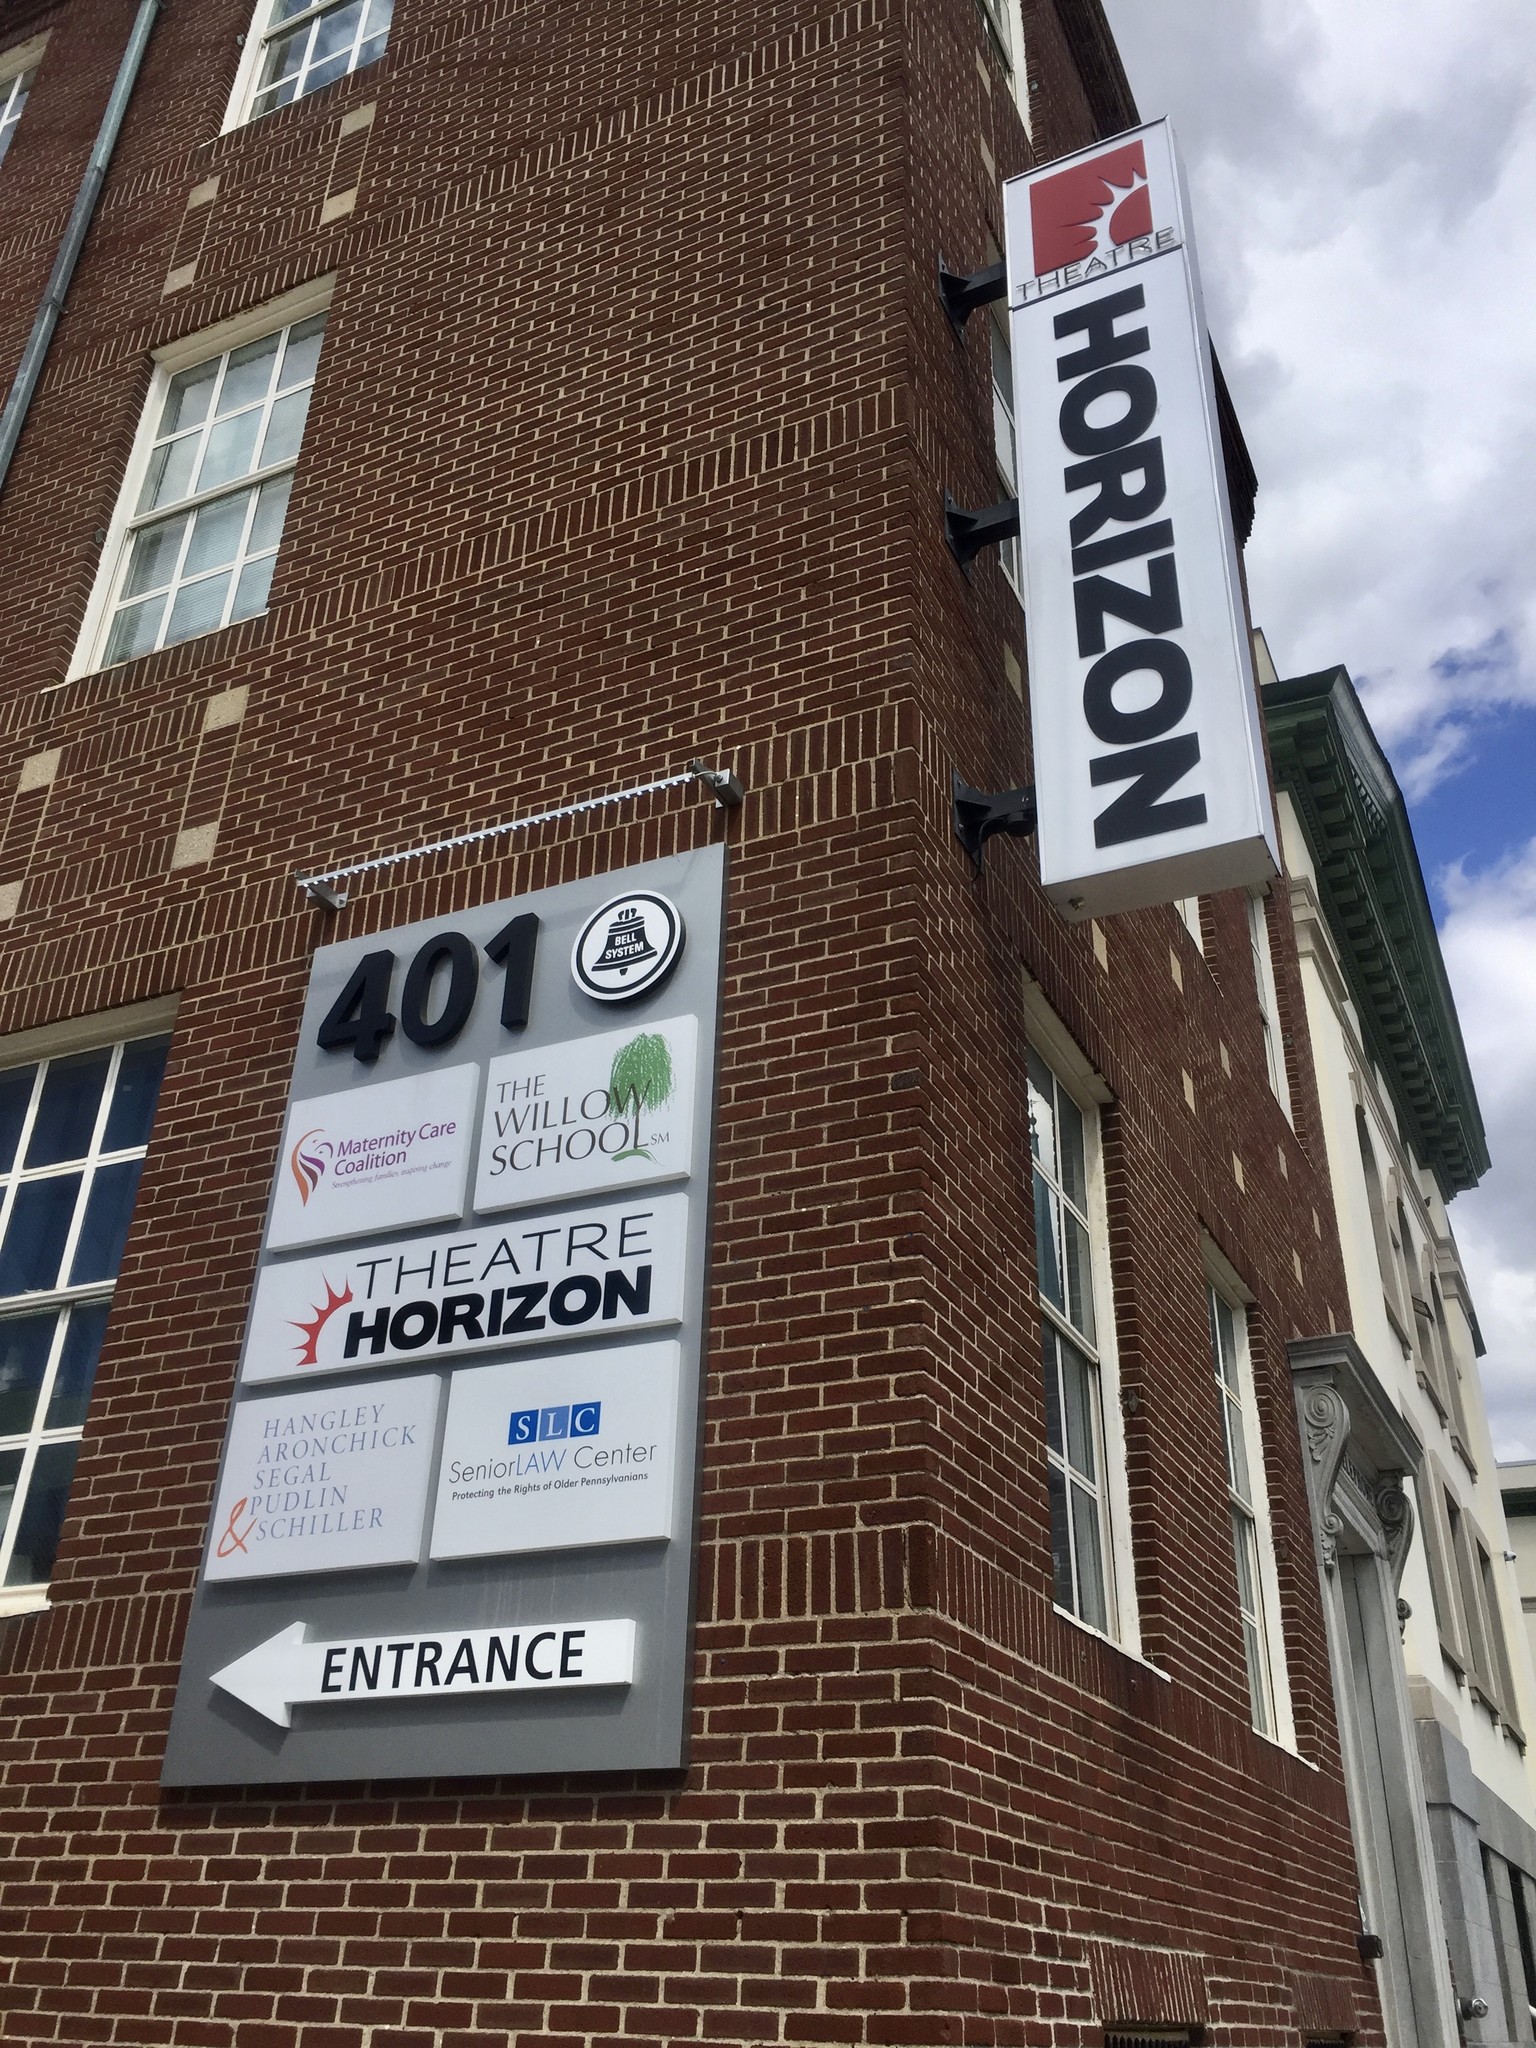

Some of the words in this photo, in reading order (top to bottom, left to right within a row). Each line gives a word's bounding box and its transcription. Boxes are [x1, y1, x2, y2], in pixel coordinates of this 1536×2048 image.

[1016, 226, 1175, 301] THEATRE
[1053, 283, 1208, 849] HORIZON
[605, 941, 644, 960] SYSTEM
[614, 932, 637, 946] BELL
[317, 912, 540, 1063] 401
[497, 1074, 546, 1103] THE
[494, 1080, 652, 1137] WILLOW
[337, 1129, 417, 1157] Maternity
[419, 1121, 457, 1140] Care
[490, 1112, 649, 1176] SCHOOL
[334, 1150, 407, 1176] Coalition
[356, 1212, 654, 1299] THEATRE
[343, 1264, 653, 1359] HORIZON
[263, 1404, 385, 1439] HANGLEY
[256, 1424, 417, 1464] ARONCHICK
[254, 1462, 331, 1489] SEGAL
[449, 1448, 567, 1484] SeniorLAW
[573, 1443, 658, 1469] Center
[249, 1485, 348, 1516] PUDLIN
[451, 1488, 495, 1501] Protecting
[497, 1486, 512, 1496] the
[514, 1483, 541, 1496] Rights
[543, 1481, 552, 1490] of
[554, 1479, 579, 1490] Older
[580, 1472, 649, 1487] Pennsylvanians
[256, 1507, 384, 1541] SCHILLER
[320, 1629, 586, 1693] ENTRANCE
